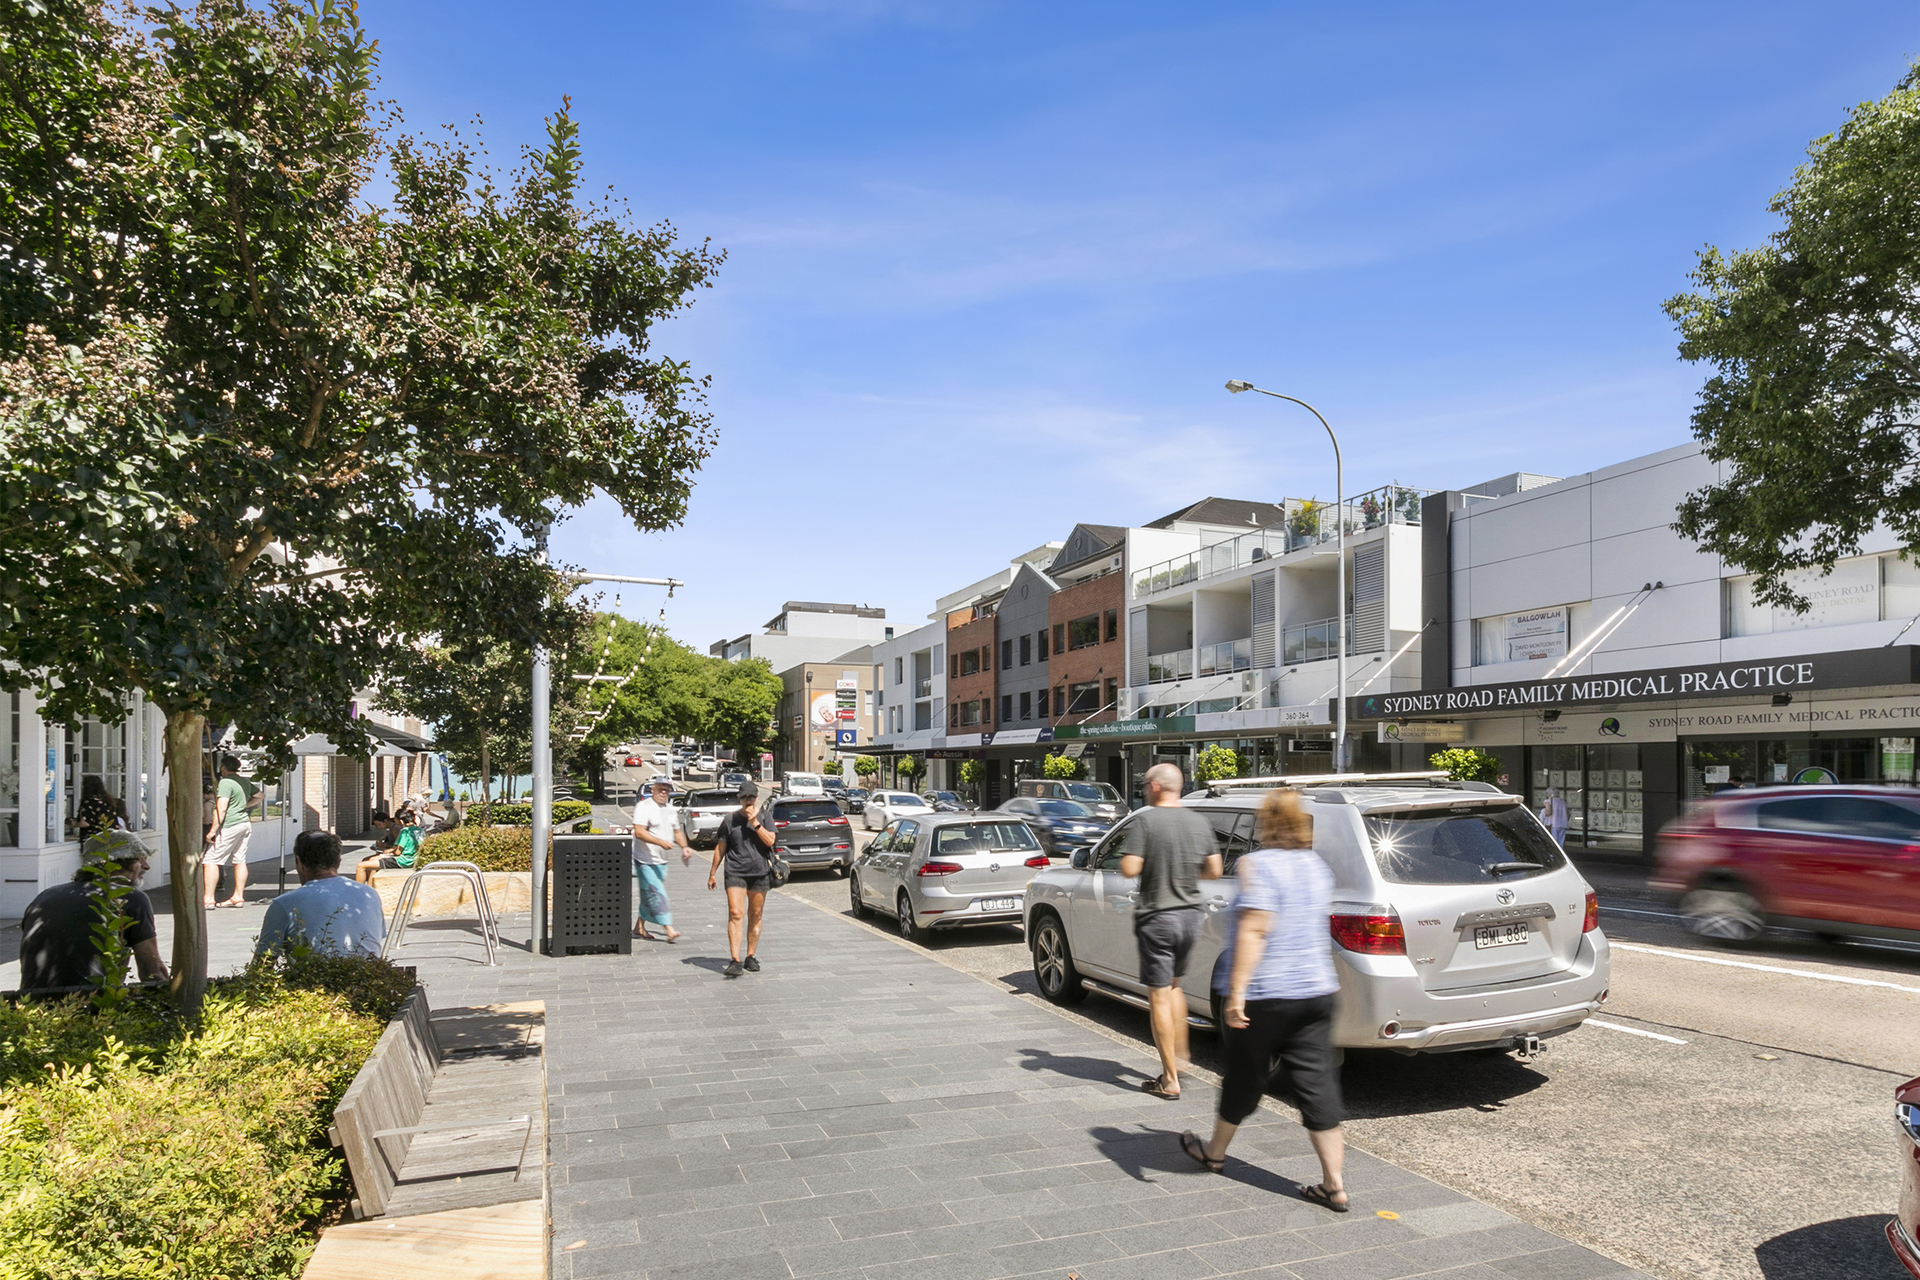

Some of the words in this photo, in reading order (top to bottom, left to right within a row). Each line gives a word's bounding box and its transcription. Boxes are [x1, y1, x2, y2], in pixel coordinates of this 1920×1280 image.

[1796, 588, 1839, 600] DNEY
[1841, 583, 1875, 596] ROAD
[1829, 595, 1867, 607] DENTAL
[1517, 611, 1561, 624] BALGOWLAH
[1383, 694, 1443, 714] SYDNEY
[1446, 690, 1494, 709] ROAD
[1497, 683, 1567, 706] FAMILY
[1571, 674, 1675, 700] MEDICAL
[1679, 662, 1815, 694] PRACTICE
[1648, 716, 1694, 728] SYDNEY
[1697, 714, 1733, 726] ROAD
[1736, 712, 1784, 724] FAMILY
[1789, 709, 1854, 722] MEDICAL
